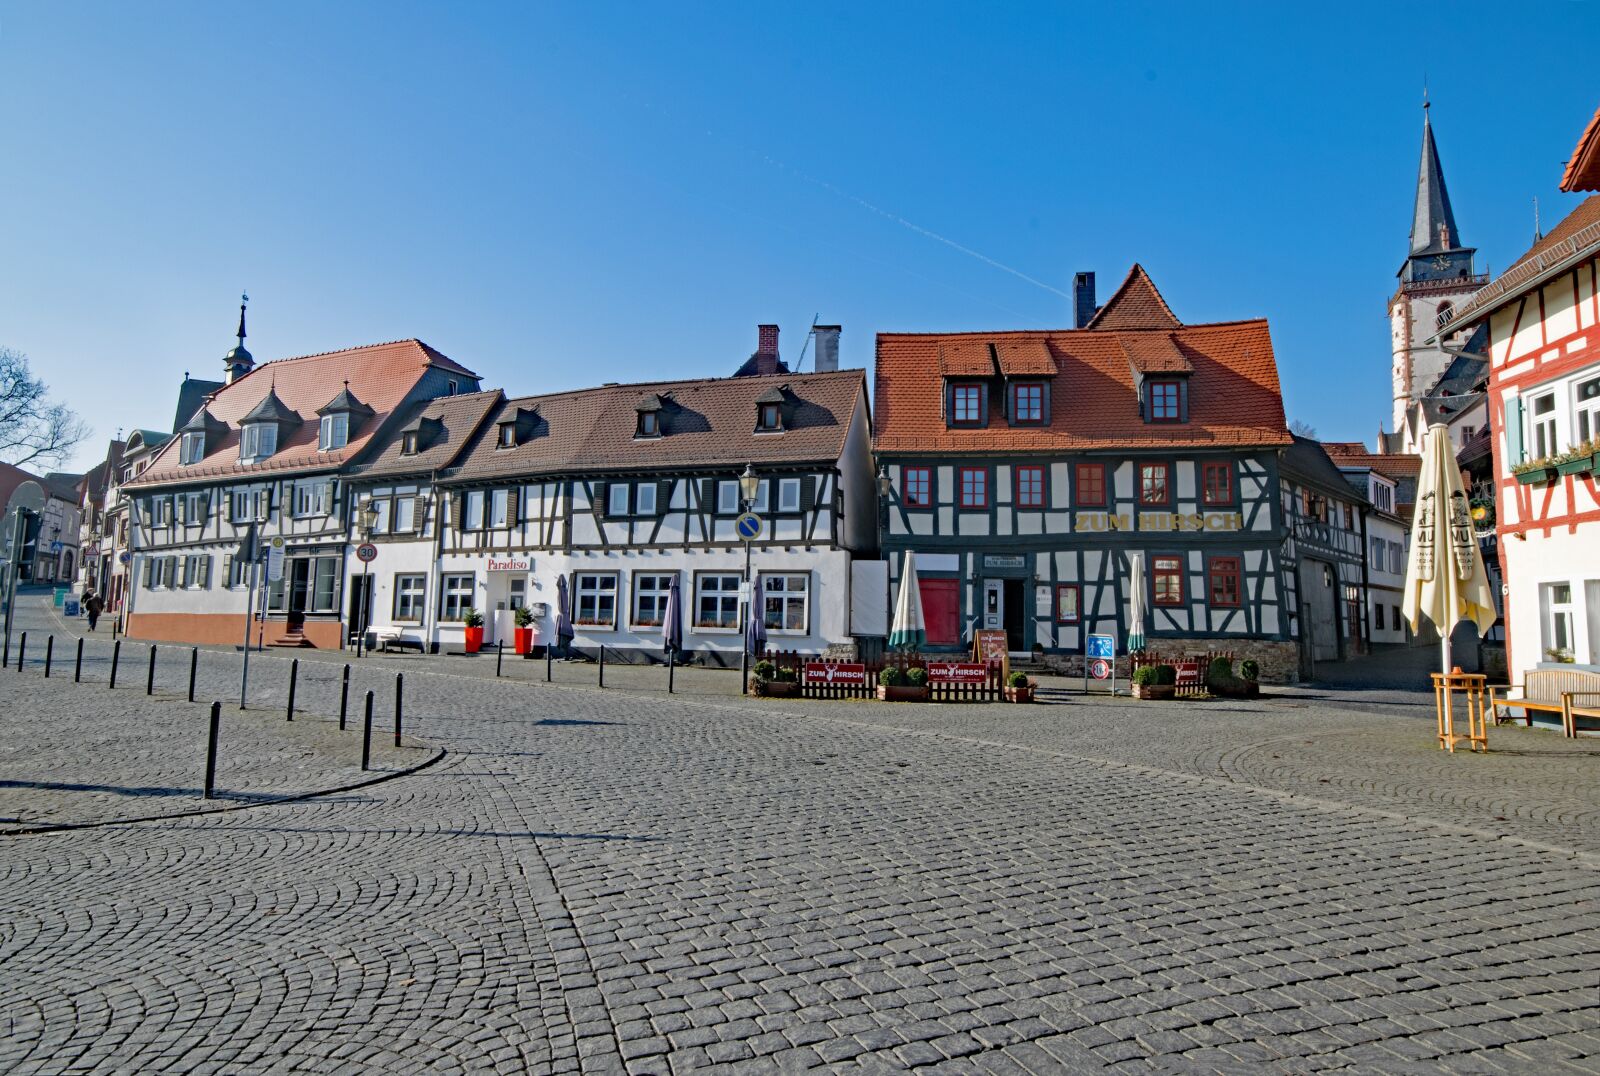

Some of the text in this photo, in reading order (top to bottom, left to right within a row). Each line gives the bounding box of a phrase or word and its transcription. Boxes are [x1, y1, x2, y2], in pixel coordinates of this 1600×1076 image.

[1074, 513, 1245, 531] ZUM HIRSCH
[361, 548, 373, 557] 30
[488, 558, 527, 570] Paradiso
[1502, 584, 1509, 596] 6
[834, 671, 863, 679] HIRSCH
